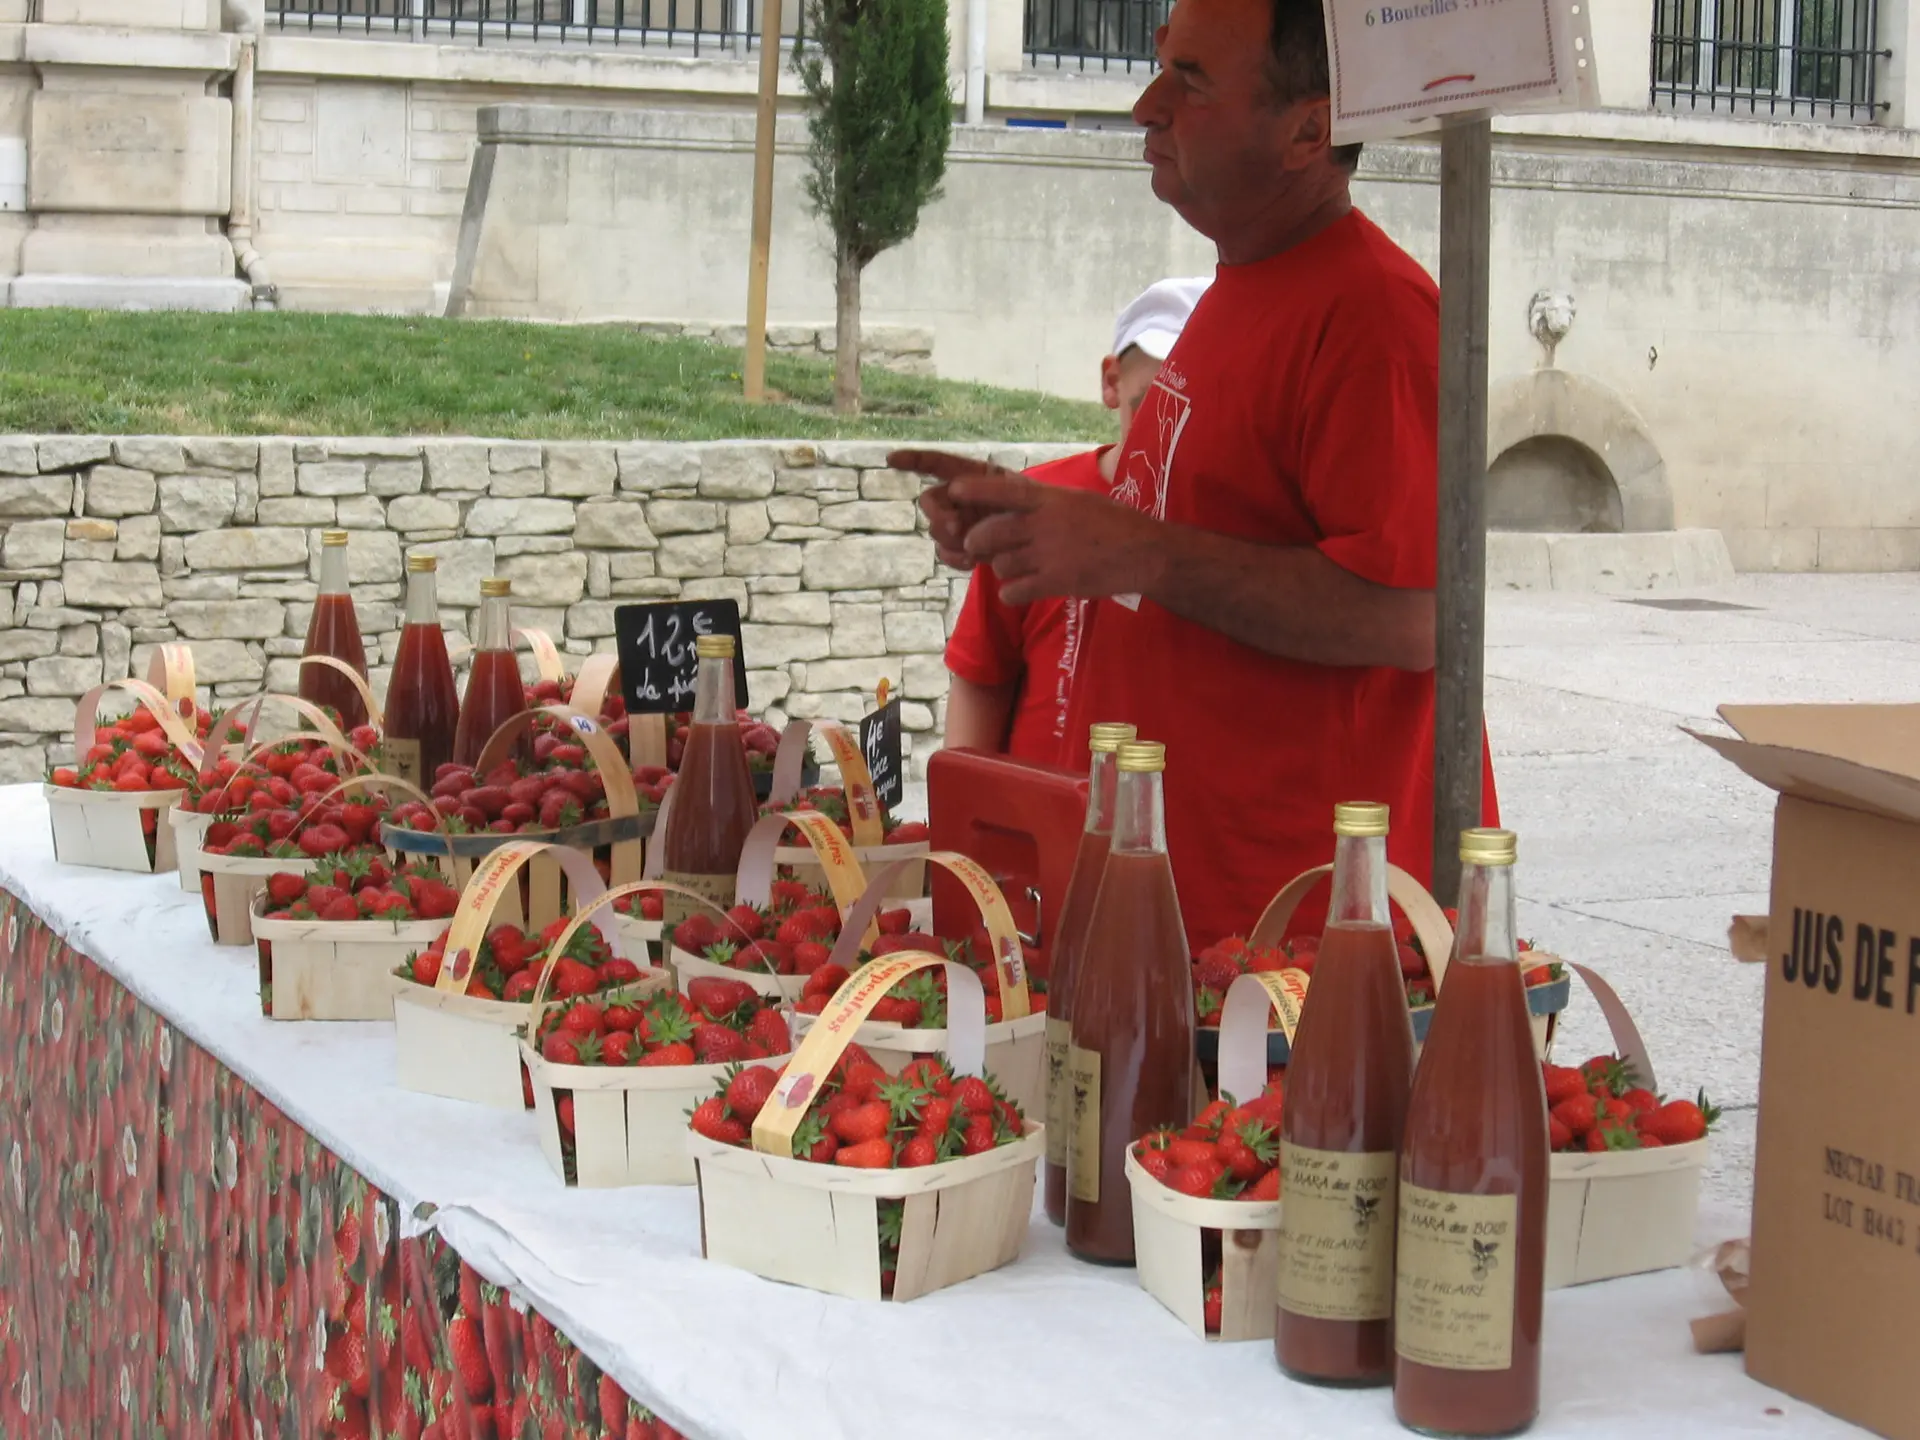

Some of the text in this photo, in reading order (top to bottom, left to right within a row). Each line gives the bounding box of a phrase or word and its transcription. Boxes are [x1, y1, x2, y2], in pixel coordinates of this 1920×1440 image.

[1364, 0, 1459, 27] 6 Bouteilles
[1782, 906, 1844, 995] JUS
[1852, 922, 1896, 1009] DE
[1823, 1192, 1854, 1228] LOT
